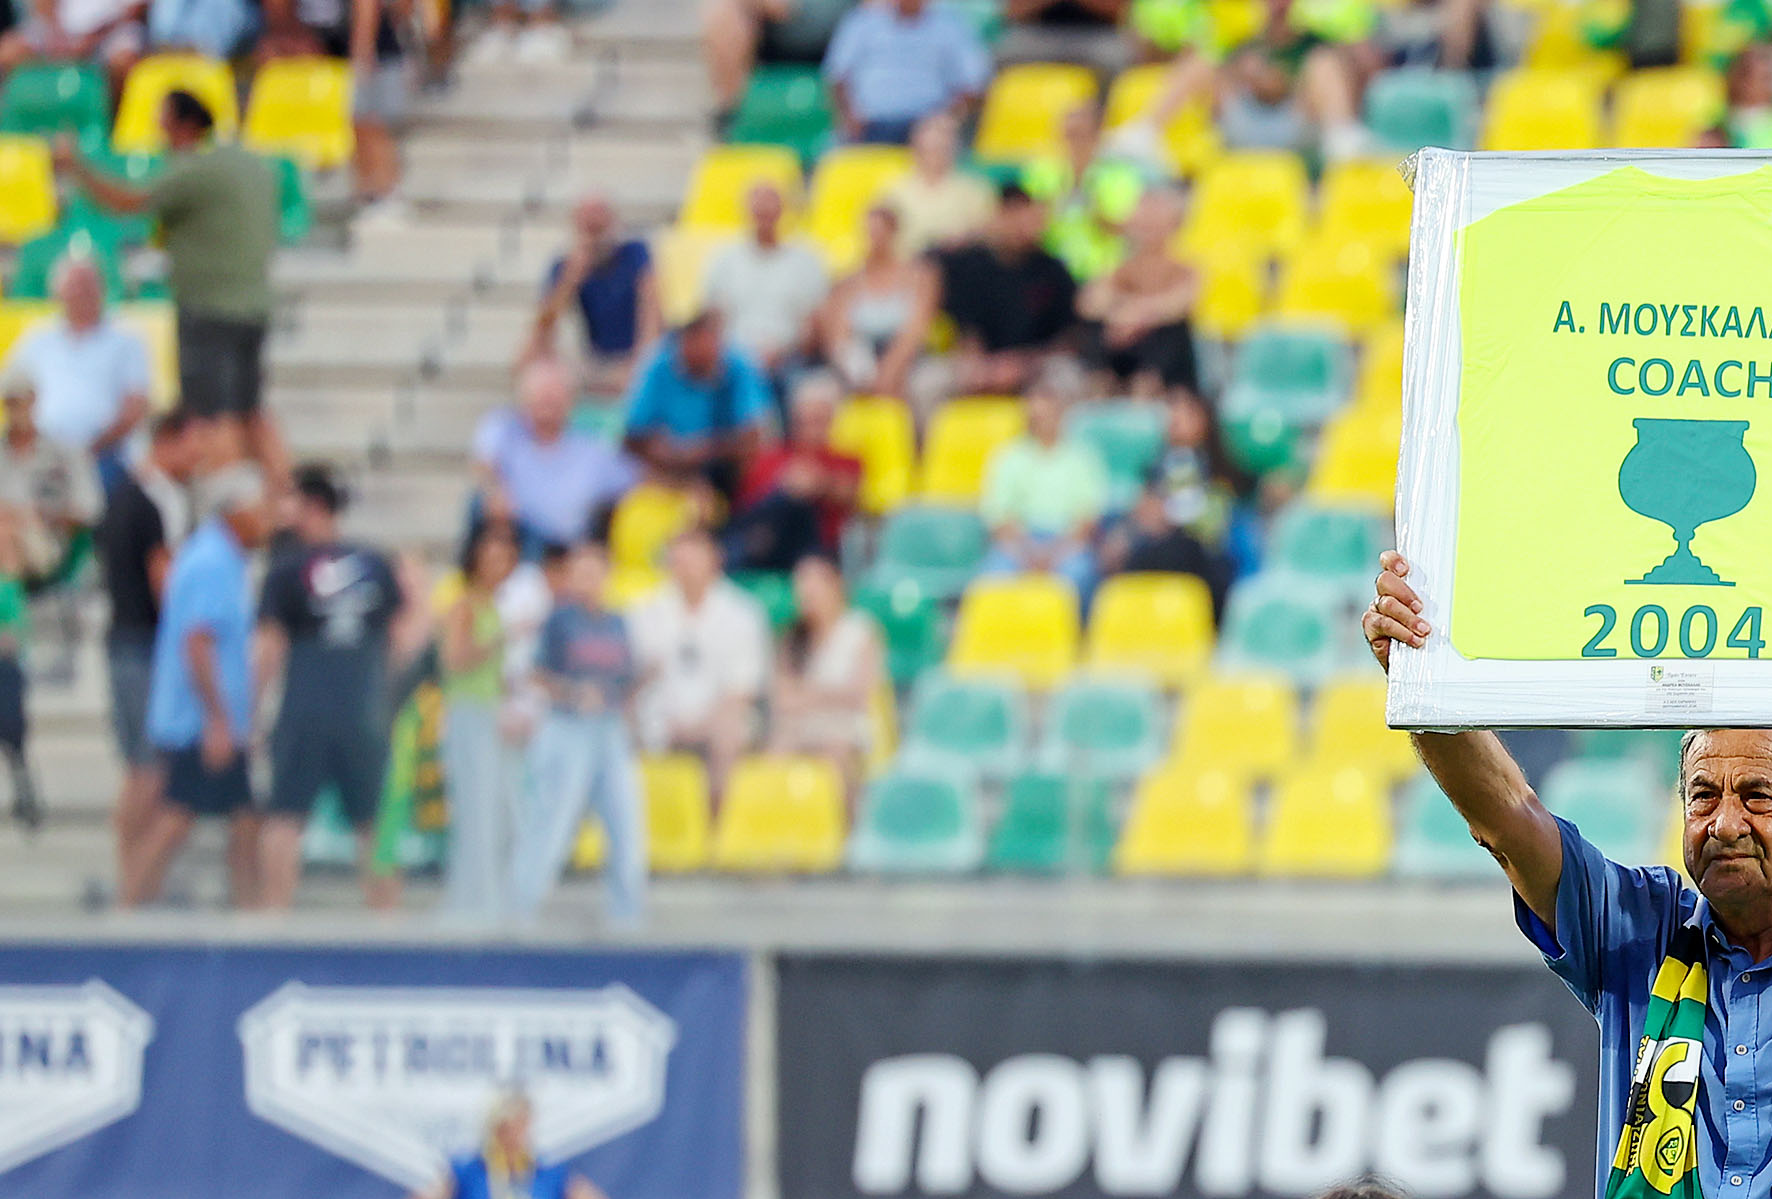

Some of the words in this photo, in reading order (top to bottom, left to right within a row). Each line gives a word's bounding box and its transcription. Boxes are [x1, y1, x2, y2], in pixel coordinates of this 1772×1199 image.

[1553, 300, 1585, 333] Α.
[1581, 604, 1766, 659] 2004
[295, 1028, 616, 1076] PETROLINA
